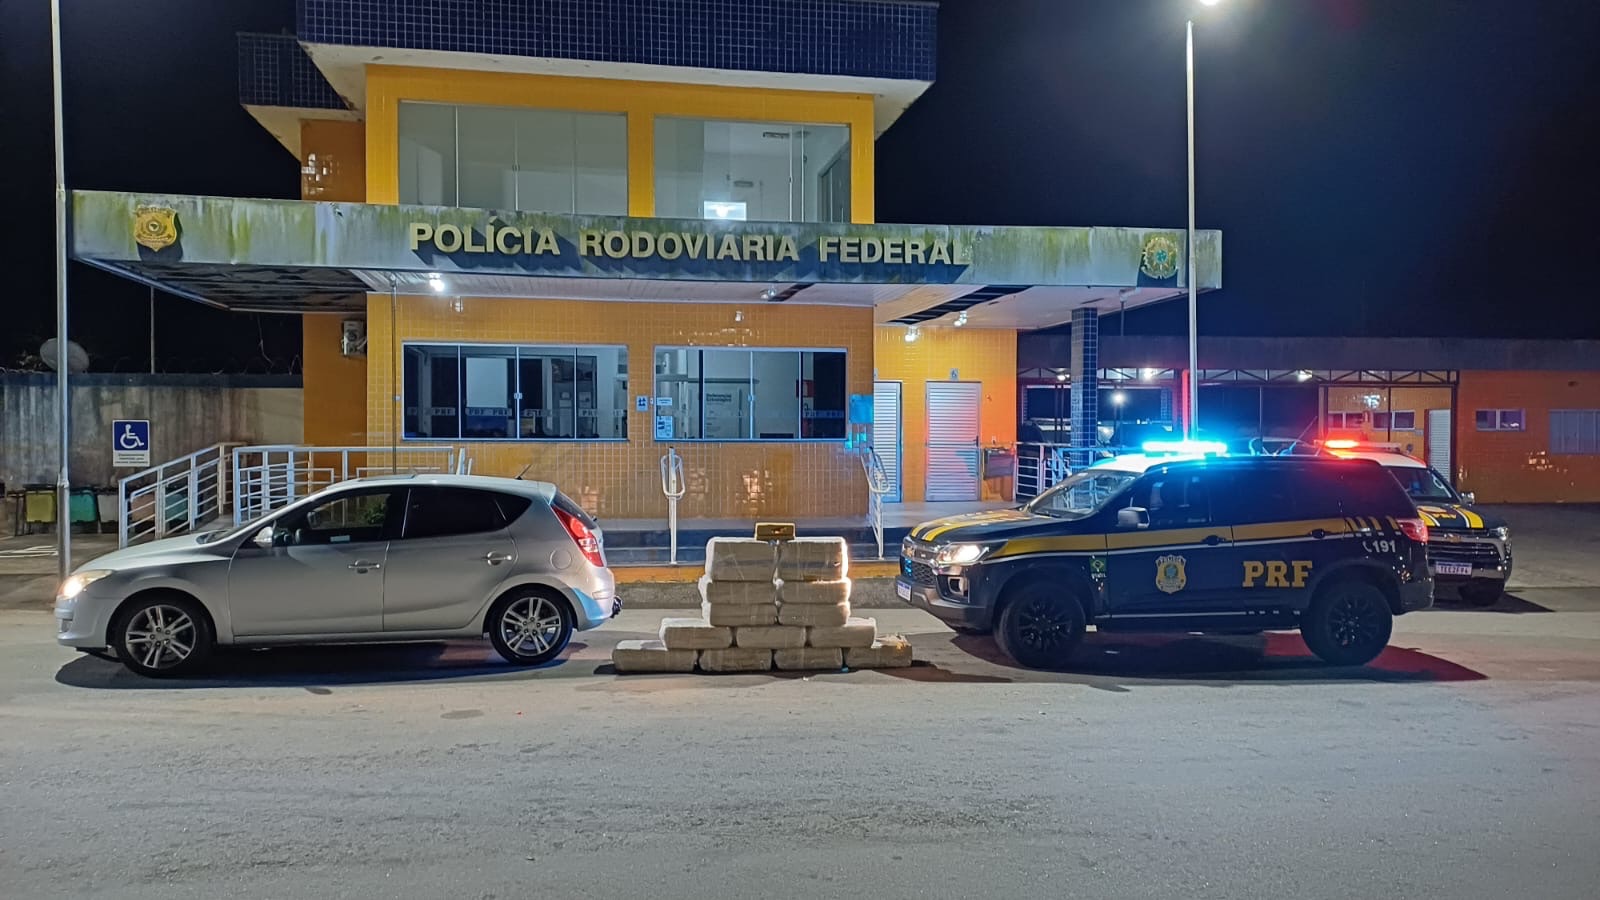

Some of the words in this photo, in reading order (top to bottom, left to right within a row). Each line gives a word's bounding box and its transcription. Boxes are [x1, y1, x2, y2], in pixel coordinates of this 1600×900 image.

[410, 216, 561, 255] POLÍCIA
[819, 236, 973, 265] FEDERAL
[1373, 540, 1395, 552] 191
[1242, 560, 1313, 588] PRF
